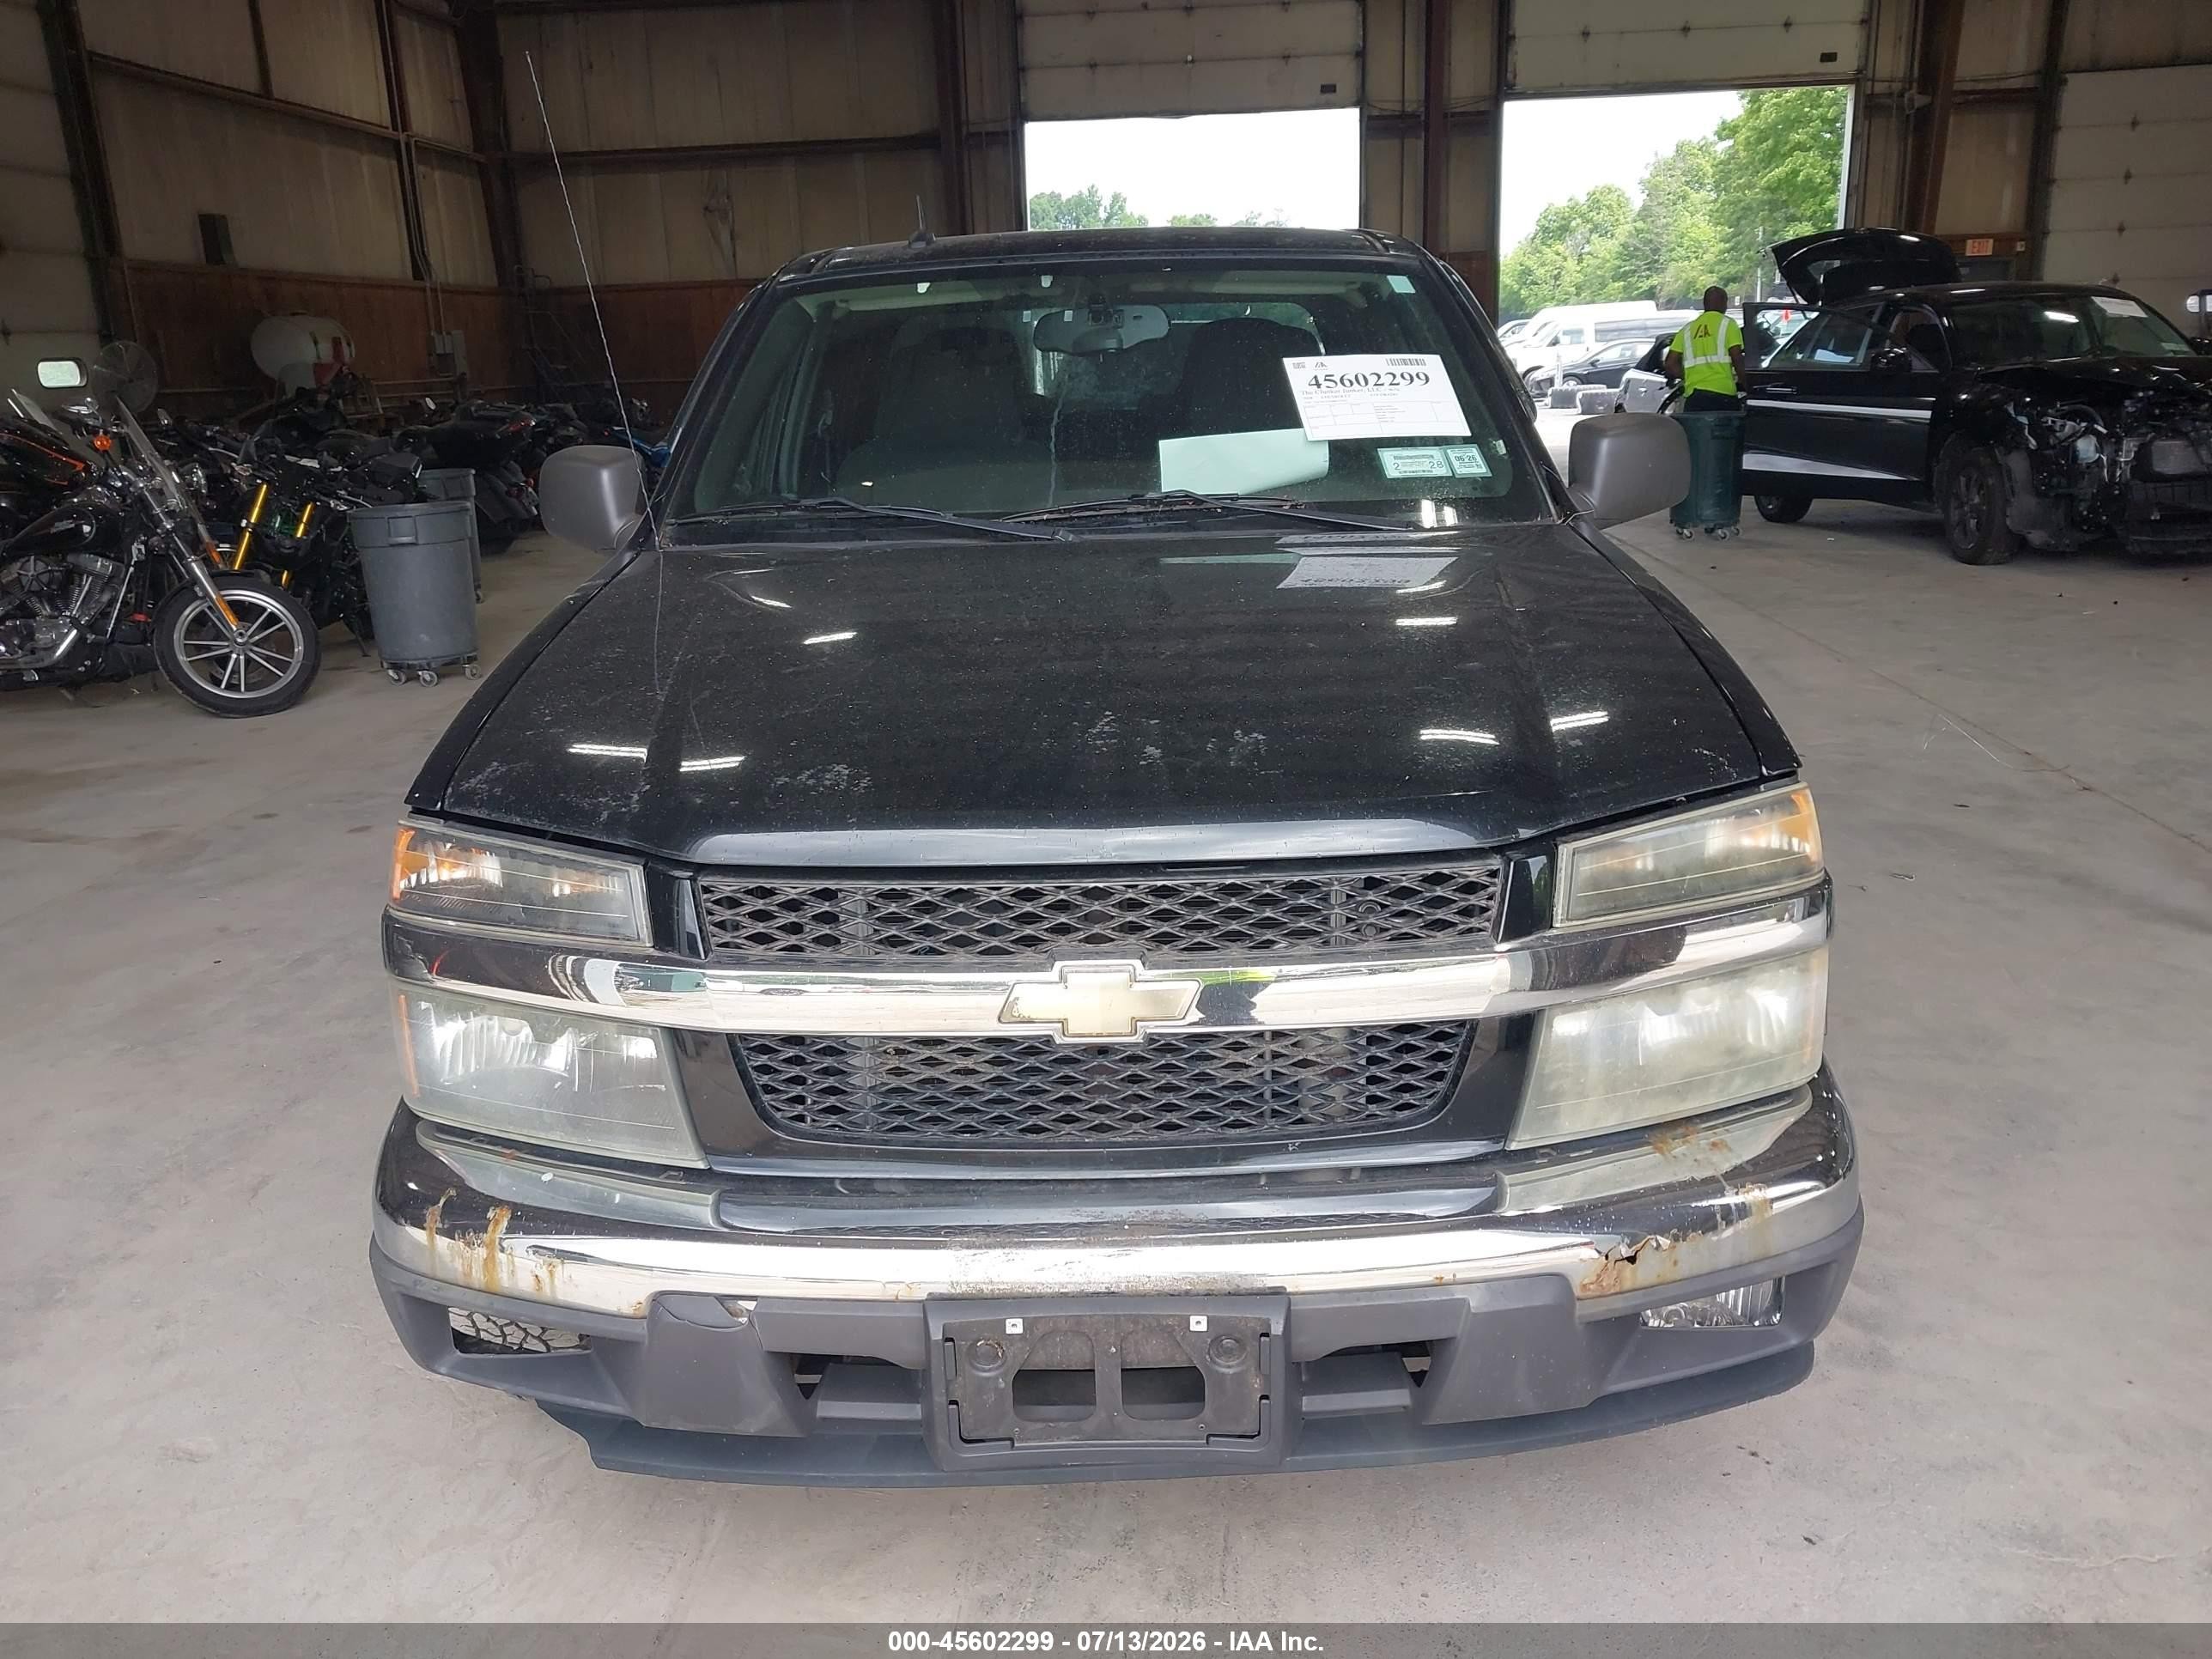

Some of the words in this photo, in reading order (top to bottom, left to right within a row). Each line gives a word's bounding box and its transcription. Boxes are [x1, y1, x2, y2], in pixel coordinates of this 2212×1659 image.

[1308, 371, 1430, 389] 45602299
[1393, 462, 1401, 471] 2
[1428, 460, 1444, 469] 28
